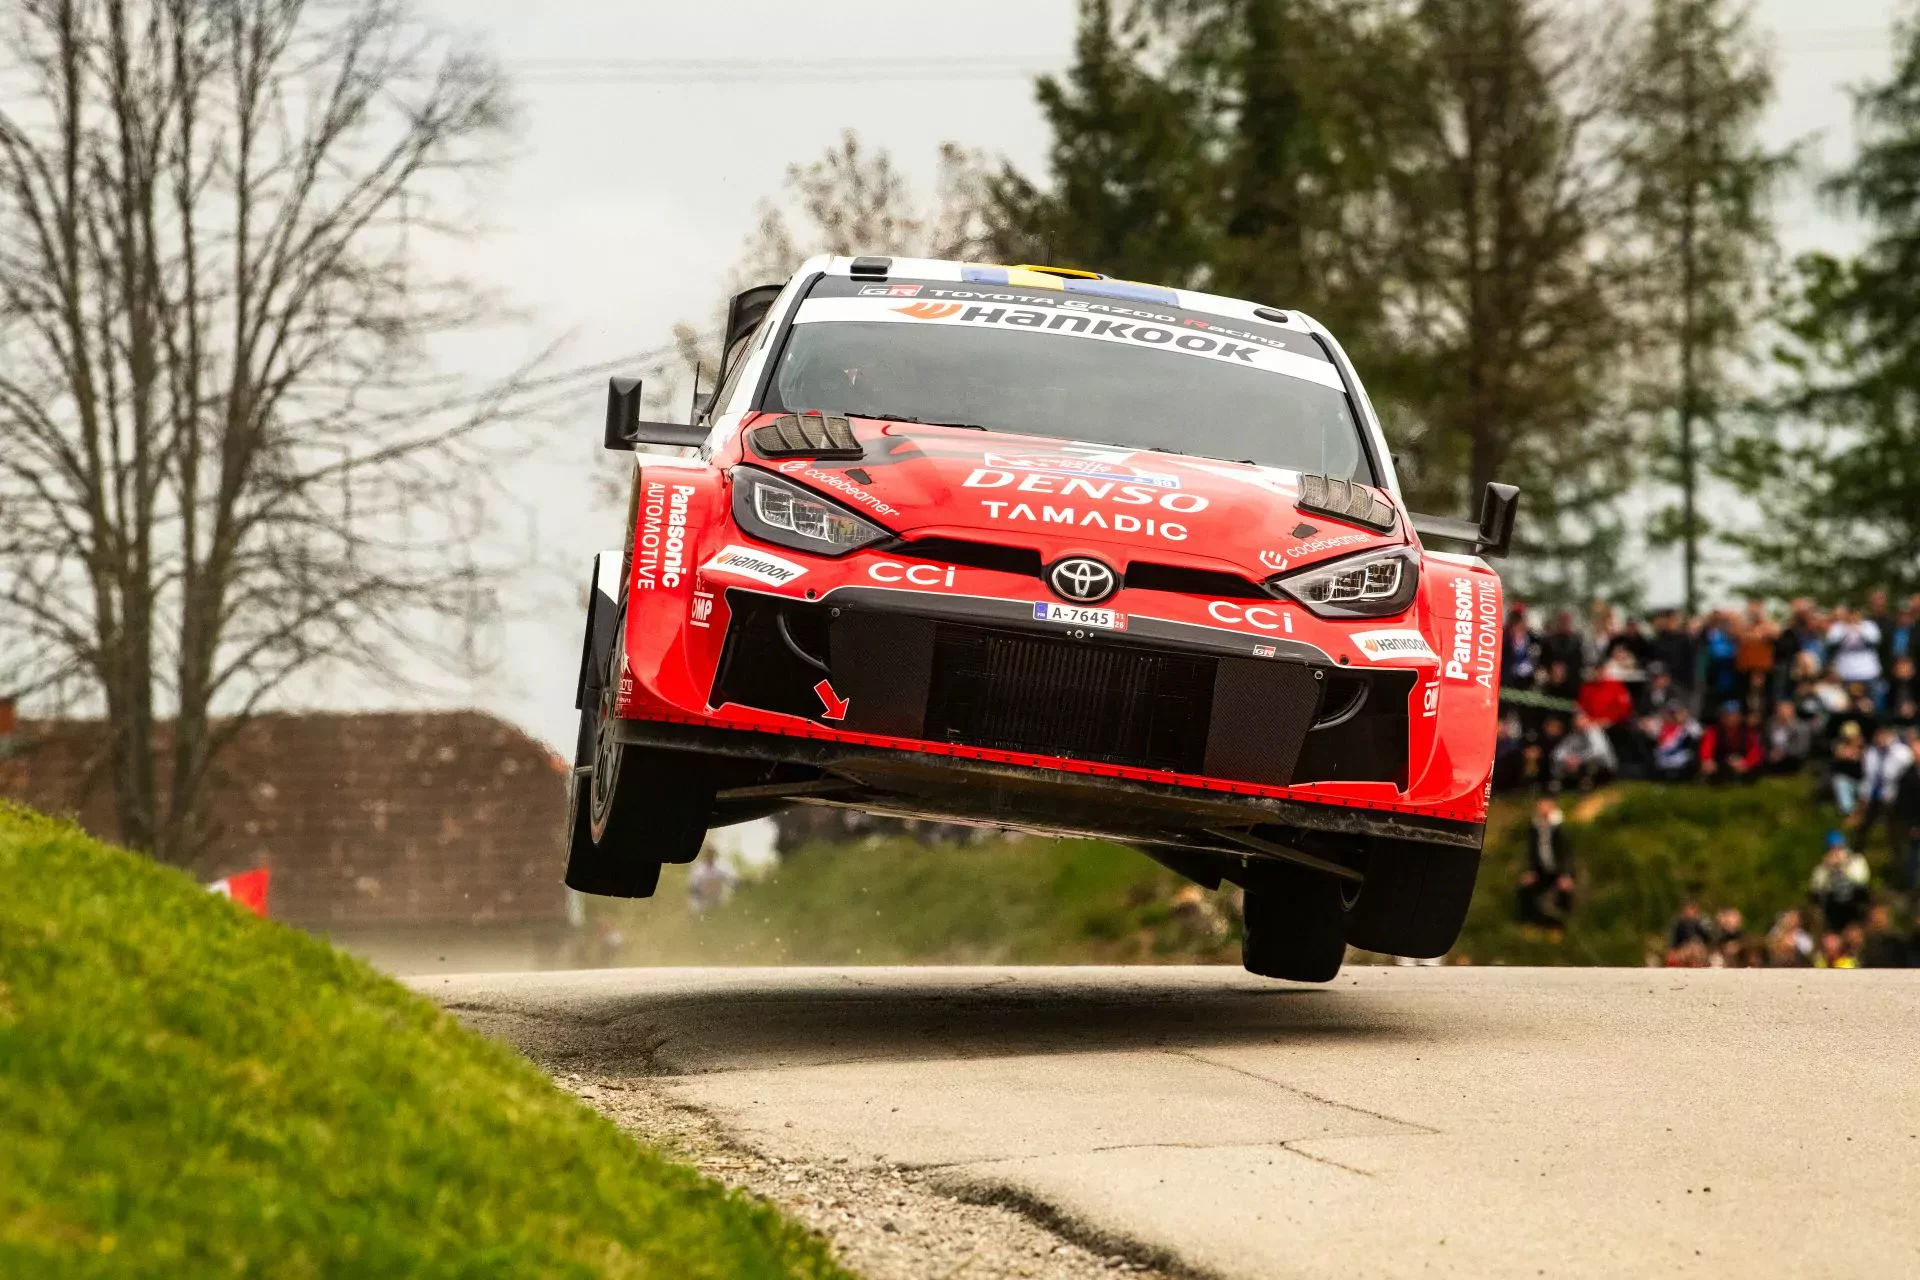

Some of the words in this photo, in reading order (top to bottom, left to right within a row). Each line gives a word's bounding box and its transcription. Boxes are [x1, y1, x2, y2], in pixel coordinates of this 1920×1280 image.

[860, 286, 919, 297] GR
[929, 289, 1055, 304] TOYOTA
[1057, 299, 1176, 323] GAZOO
[1183, 317, 1287, 348] Racing
[804, 467, 898, 517] codebeamer
[961, 468, 1210, 514] DENSO
[637, 481, 659, 590] AUTOMOTIVE
[662, 484, 695, 588] Panasonic
[980, 500, 1189, 541] TAMADIC
[1286, 533, 1372, 558] codebeamer
[691, 597, 713, 621] OMP
[1052, 607, 1109, 625] A-7645
[1445, 577, 1473, 681] Panasonic
[1475, 580, 1496, 689] AUTOMOTIVE
